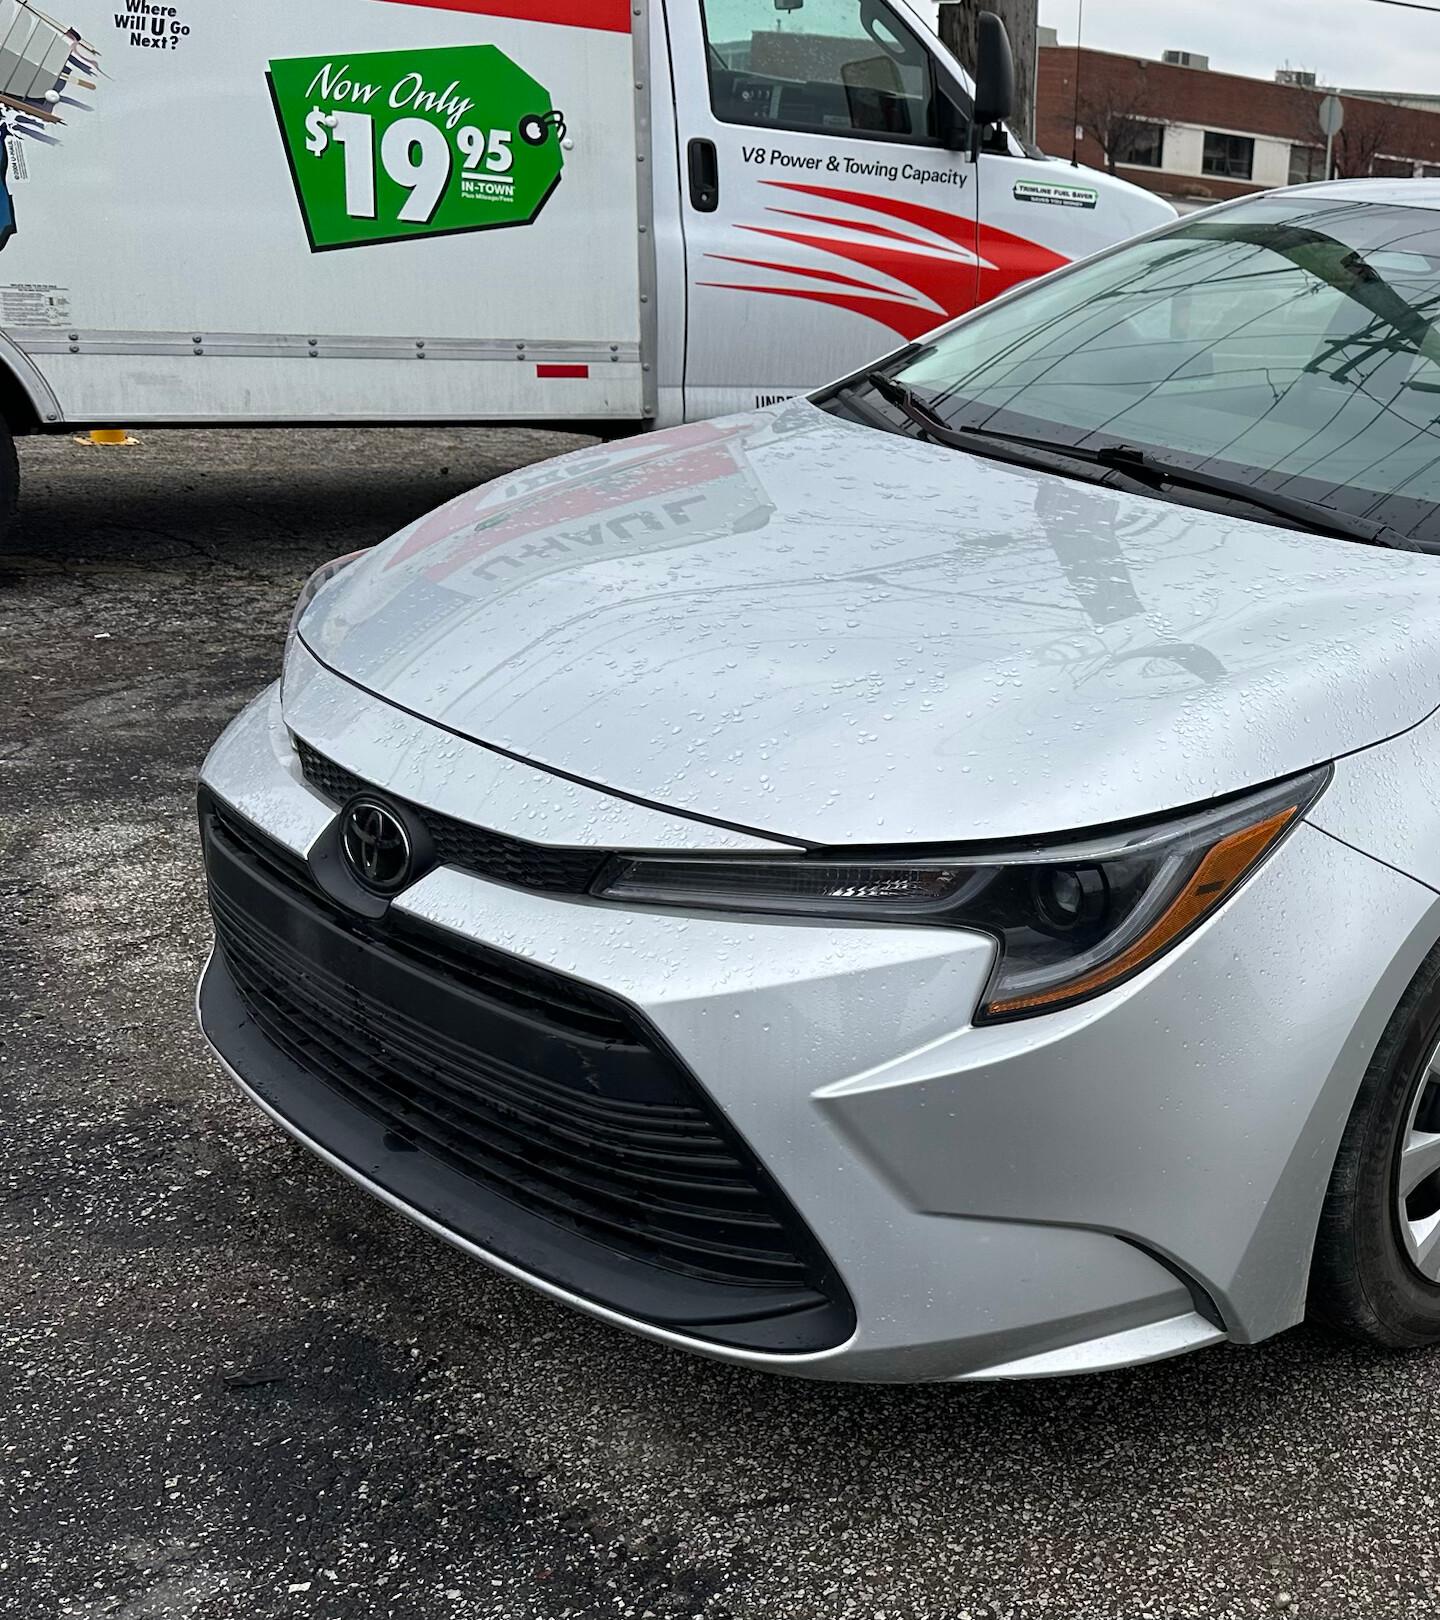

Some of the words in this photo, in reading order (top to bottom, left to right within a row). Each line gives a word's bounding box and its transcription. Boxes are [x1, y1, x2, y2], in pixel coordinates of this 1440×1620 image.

[126, 0, 177, 17] Where
[114, 14, 146, 31] Will
[151, 18, 165, 36] U
[170, 21, 190, 35] Go
[130, 32, 179, 50] Next?
[305, 63, 382, 104] Now
[388, 72, 475, 129] Only
[742, 146, 766, 164] V8
[770, 150, 822, 171] Power
[826, 155, 840, 172] &
[844, 158, 898, 181] Towing
[901, 164, 968, 189] Capacity
[461, 180, 514, 196] IN-TOWN
[1019, 185, 1052, 195] TRIMLINE
[1053, 189, 1071, 198] FUEL
[1072, 191, 1093, 200] SAVER
